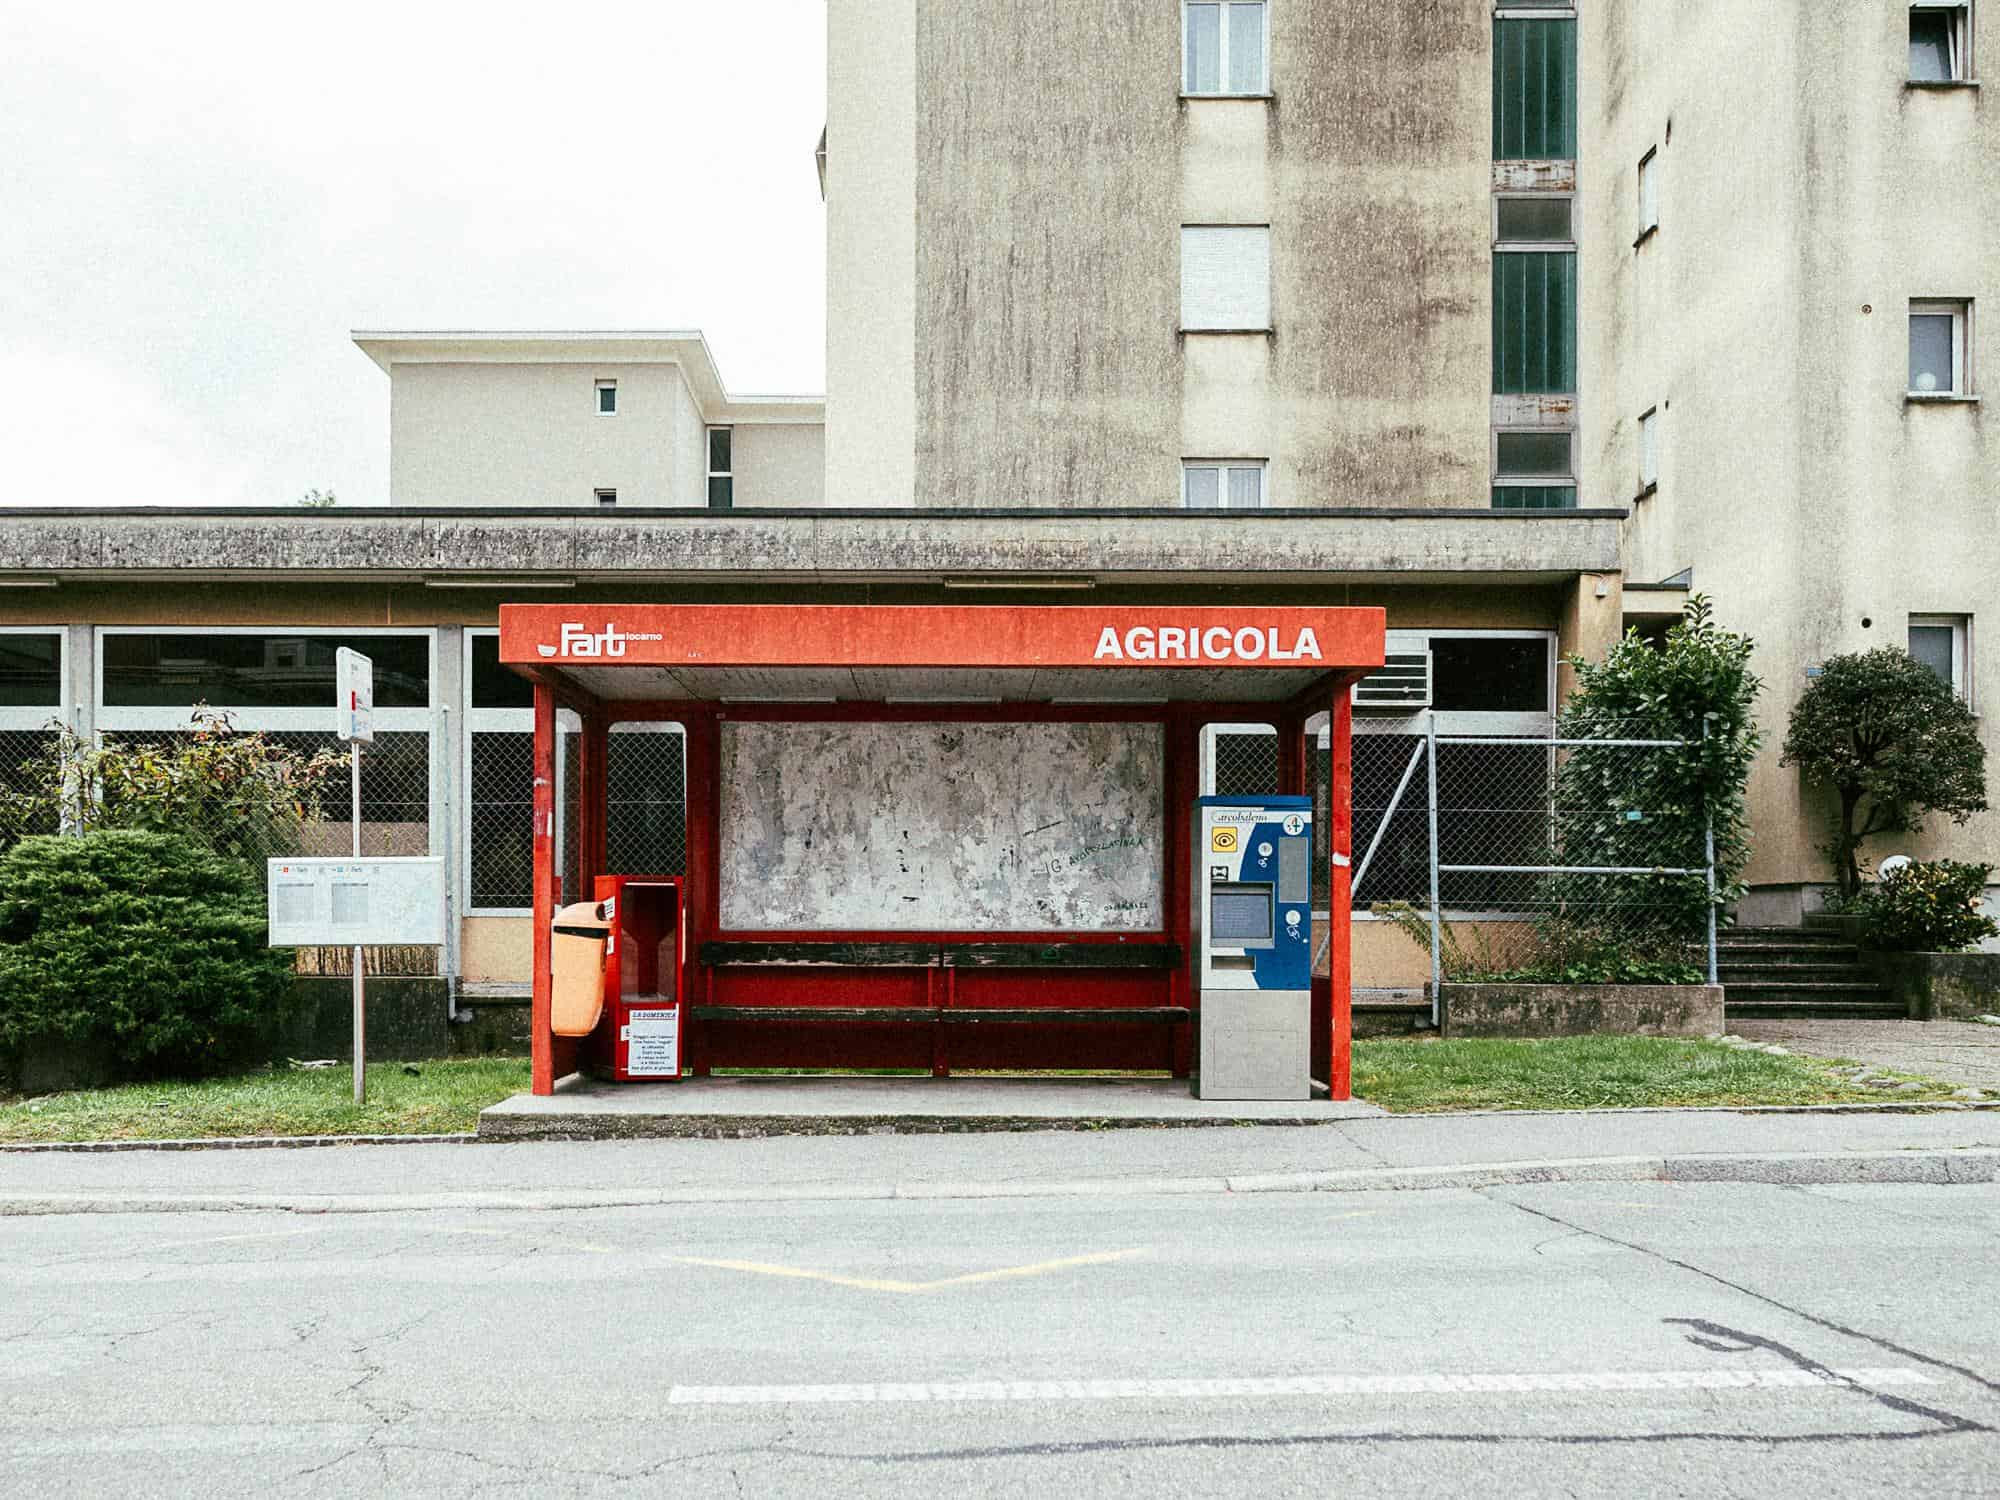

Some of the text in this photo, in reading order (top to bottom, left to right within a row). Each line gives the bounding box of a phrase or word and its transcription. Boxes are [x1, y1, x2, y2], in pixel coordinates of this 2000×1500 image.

[561, 623, 663, 657] Fart locarno
[1093, 626, 1323, 660] AGRICOLA
